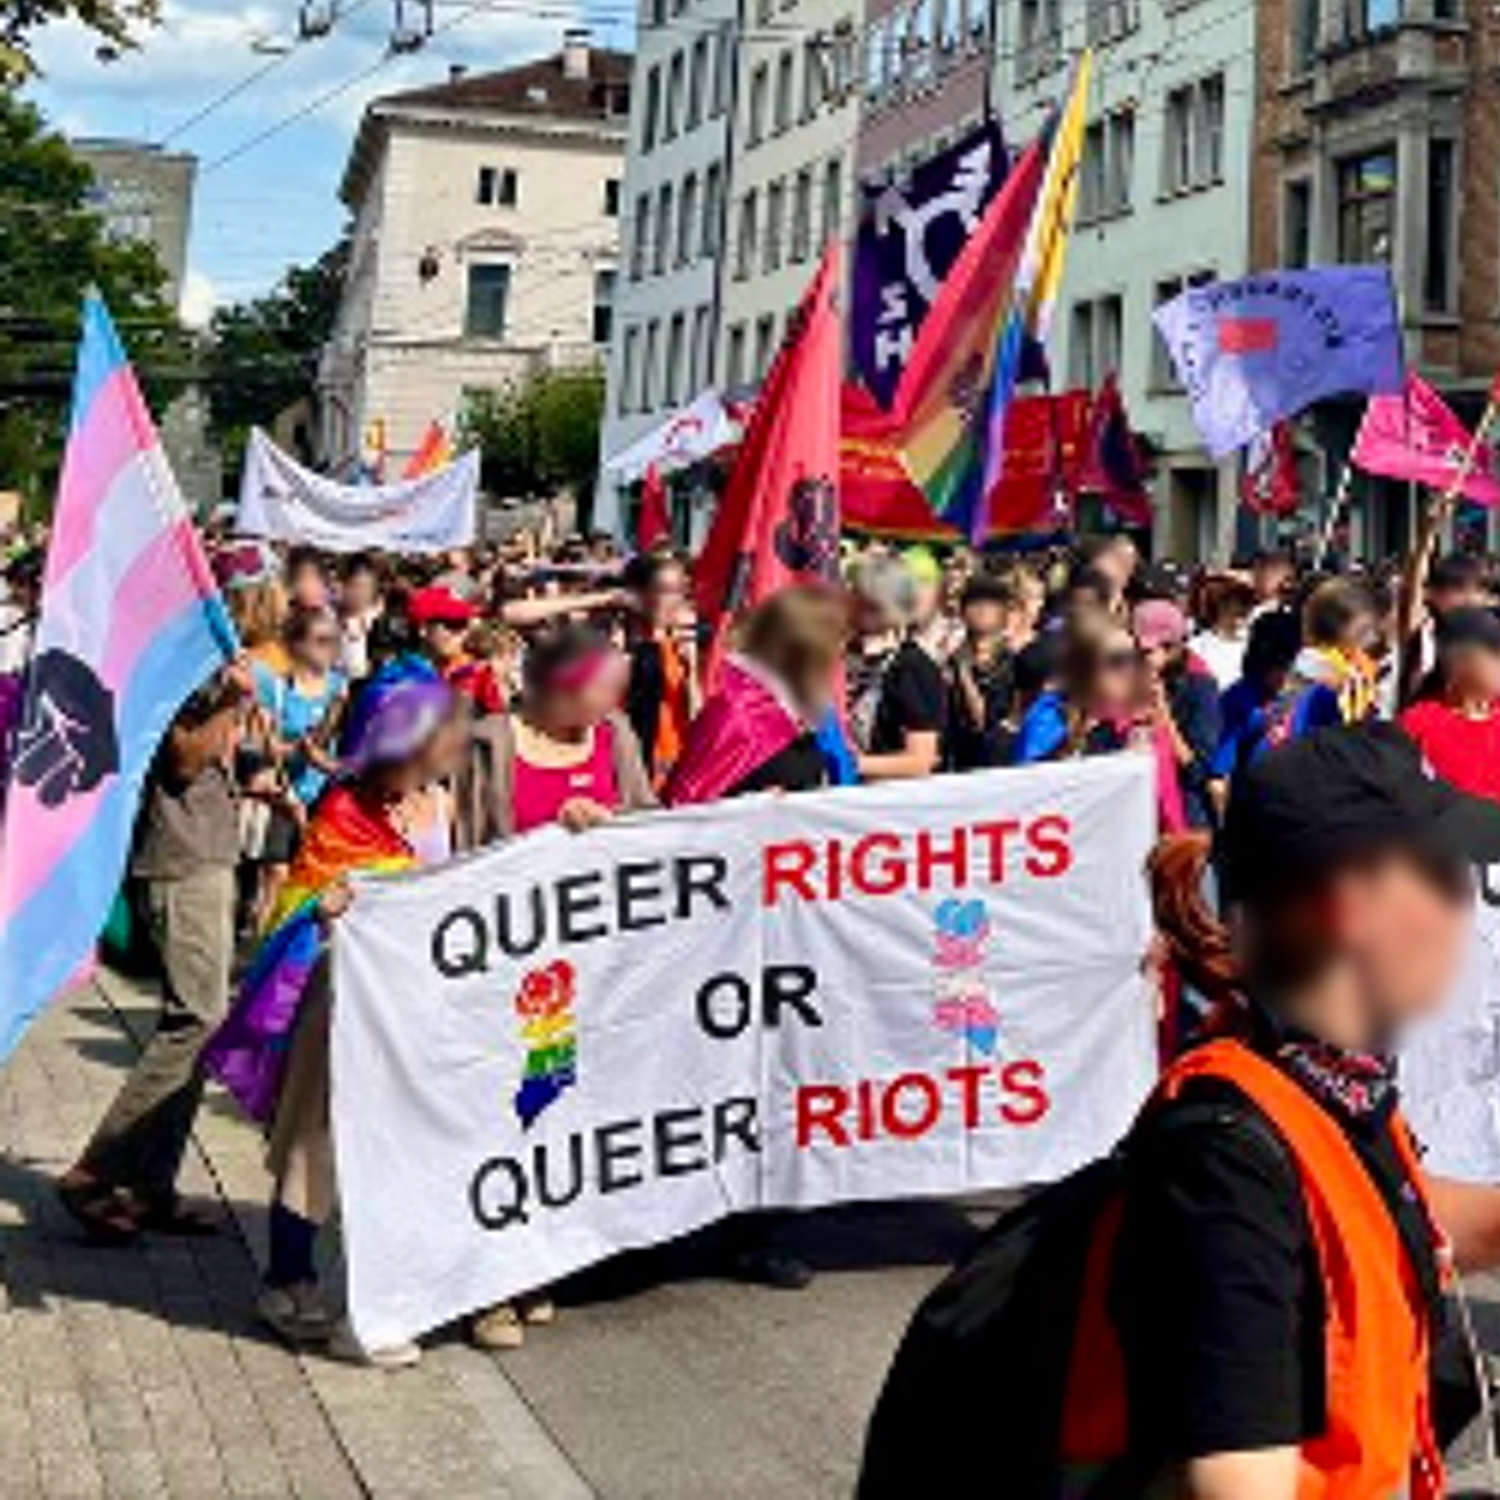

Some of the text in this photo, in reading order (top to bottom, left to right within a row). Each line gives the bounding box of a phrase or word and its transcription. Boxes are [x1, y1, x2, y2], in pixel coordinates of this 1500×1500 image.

[431, 815, 1073, 977] QUEER RIGHTS
[696, 964, 822, 1040] OR
[470, 1060, 1050, 1231] QUEER RIOTS
